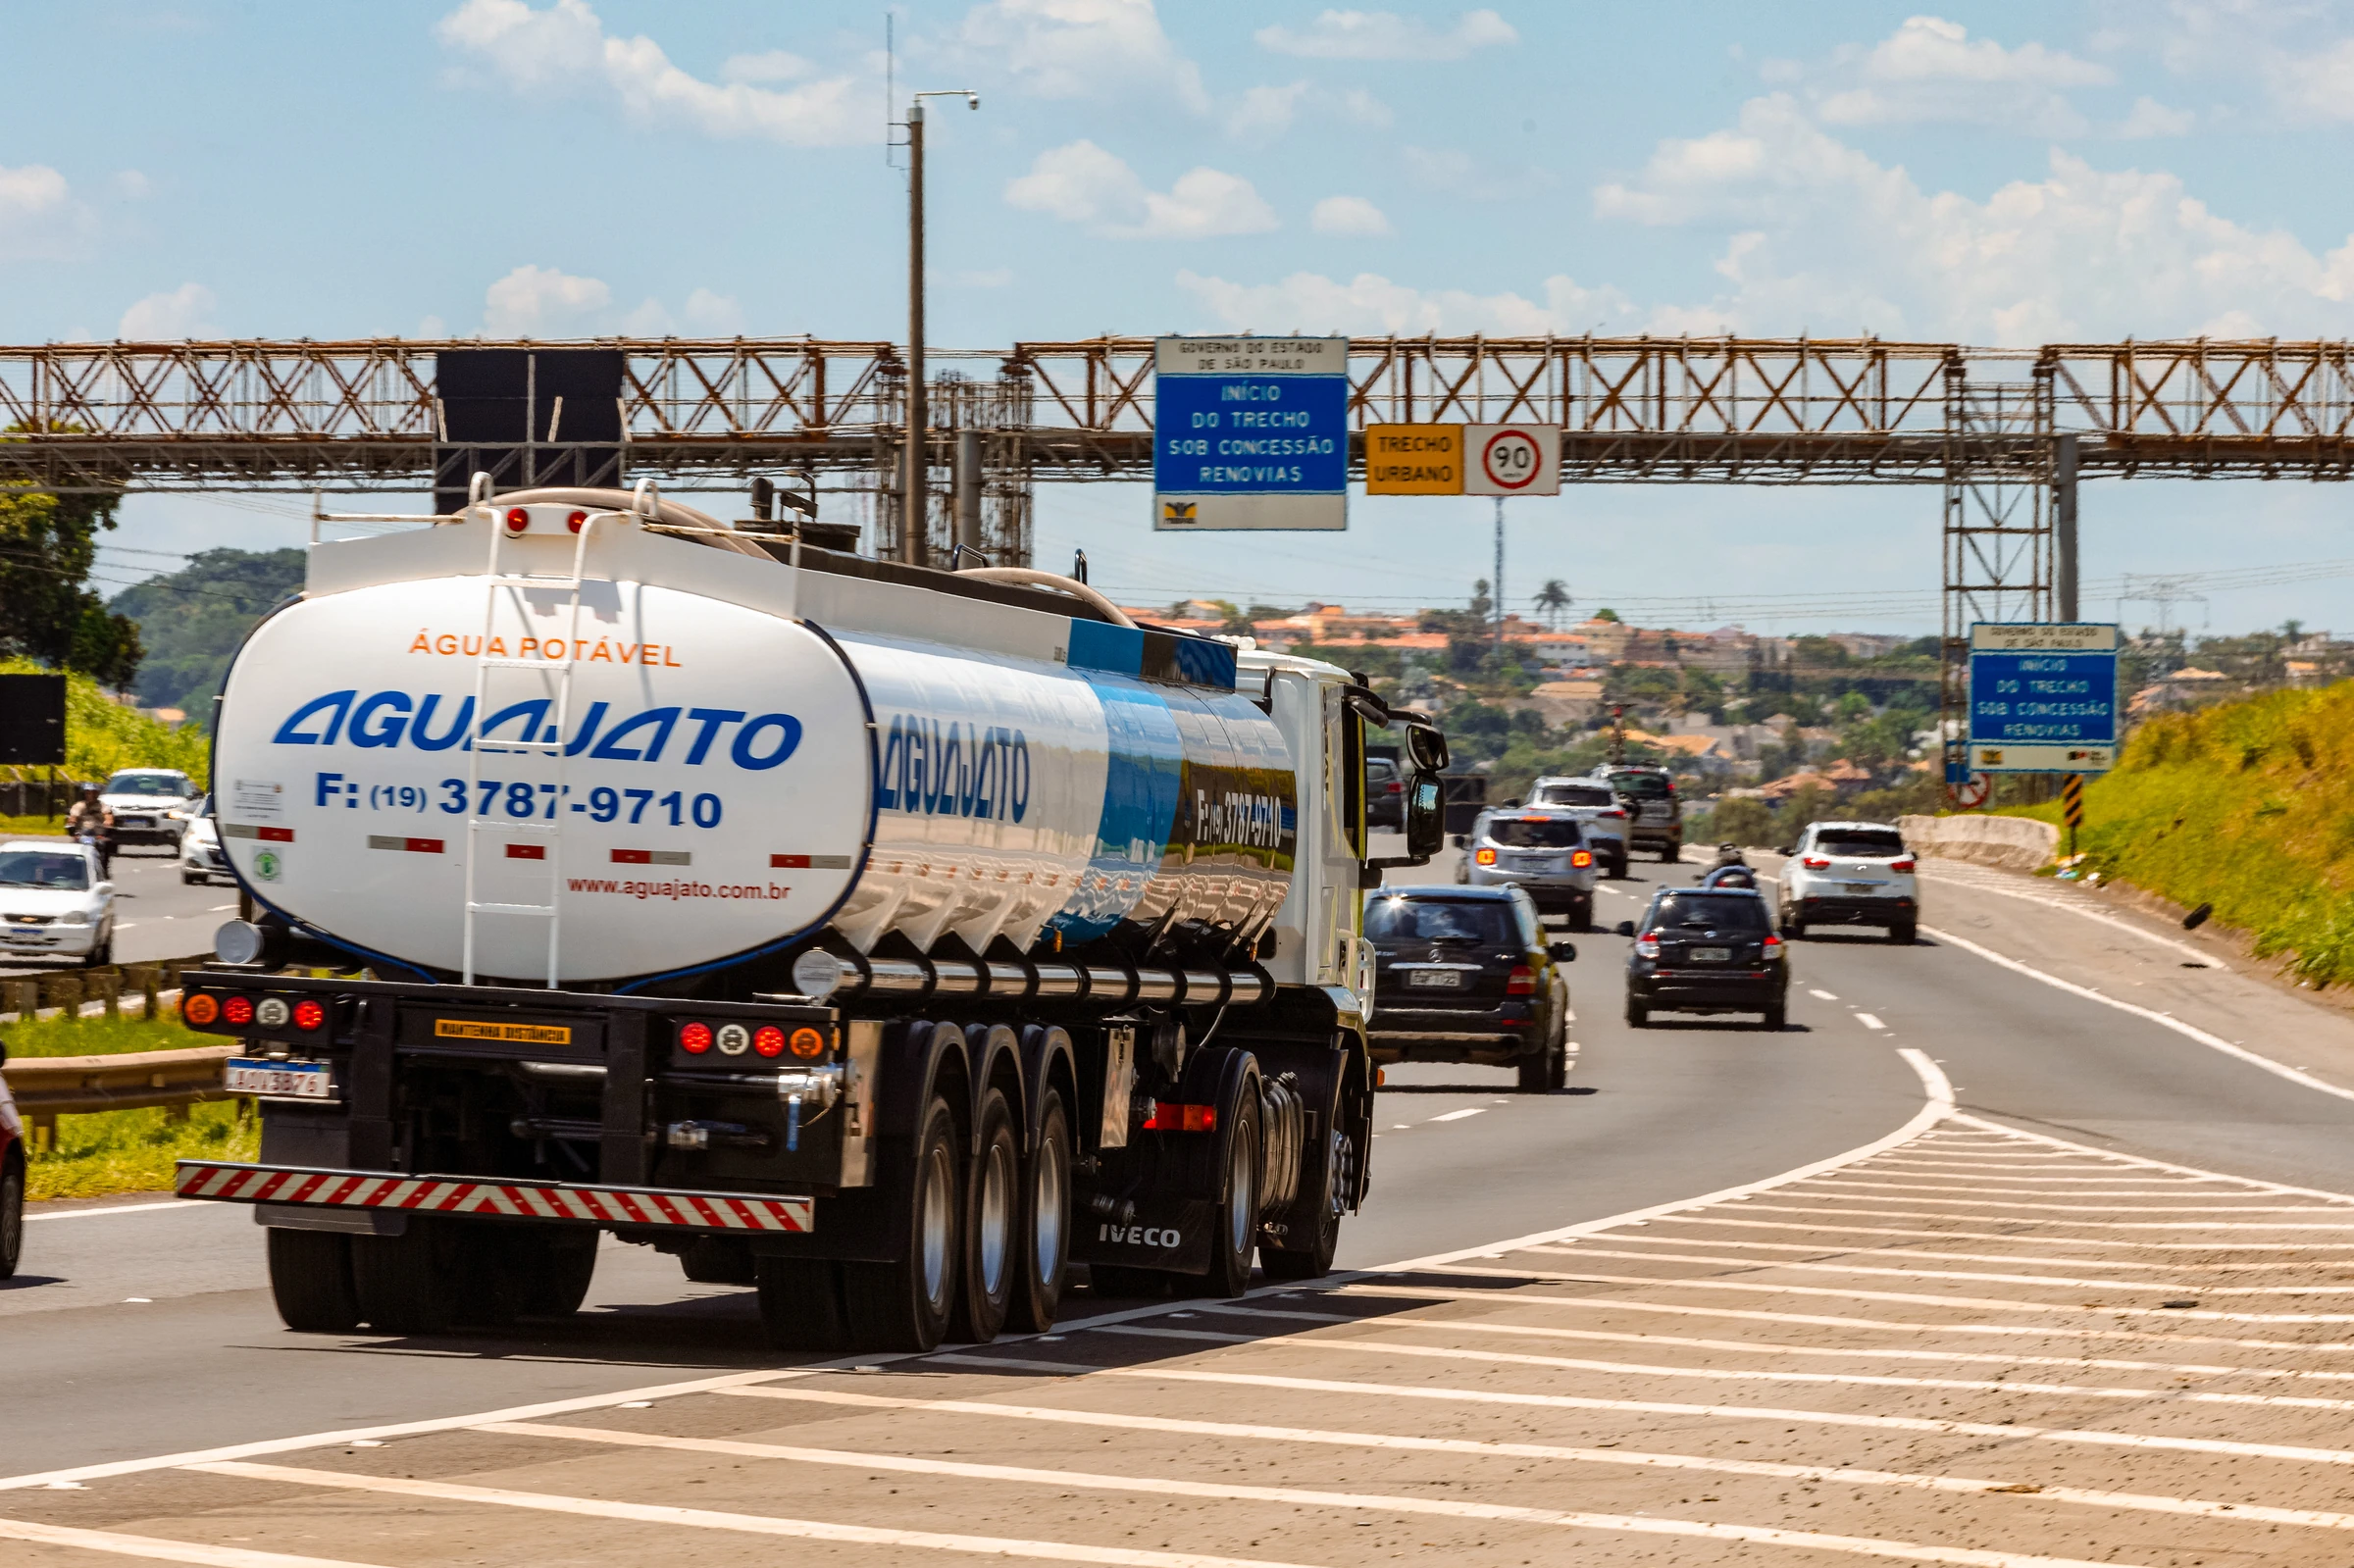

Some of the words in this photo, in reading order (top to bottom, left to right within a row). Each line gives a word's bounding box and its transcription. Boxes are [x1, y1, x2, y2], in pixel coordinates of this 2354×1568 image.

[1179, 342, 1241, 353] GOVERNO
[1246, 342, 1265, 354] DO
[1270, 342, 1324, 354] ESTADO
[1198, 358, 1216, 370] DE
[1224, 356, 1253, 370] SÃO
[1259, 358, 1305, 370] PAULO
[1221, 379, 1281, 402] INÍCIO
[1192, 412, 1220, 429] DO
[1231, 411, 1310, 429] TRECHO
[1168, 439, 1209, 456] SOB
[1218, 434, 1335, 456] CONCESSÃO
[1377, 436, 1453, 452] TRECHO
[1494, 445, 1531, 469] 90
[1200, 466, 1304, 482] RENOVIAS
[1374, 465, 1454, 482] URBANO
[408, 628, 508, 657] ÁGUA
[519, 635, 683, 668] POTÁVEL
[1996, 679, 2021, 693] DO
[2028, 679, 2090, 693] TRECHO
[1976, 701, 2010, 716] SOB
[2016, 699, 2110, 717] CONCESSÃO
[271, 689, 803, 771] AGUAJATO
[2003, 723, 2082, 736] RENOVIAS
[878, 713, 1030, 824] AGUAJATO
[316, 772, 359, 808] F:
[370, 784, 427, 813] (19)
[439, 779, 723, 830] 3787-9710
[1197, 789, 1209, 840] F:
[1209, 803, 1223, 843] (19)
[1224, 791, 1282, 848] 3787-9710
[567, 877, 792, 900] www.aguajato.com.br
[1099, 1223, 1181, 1248] IVECO
